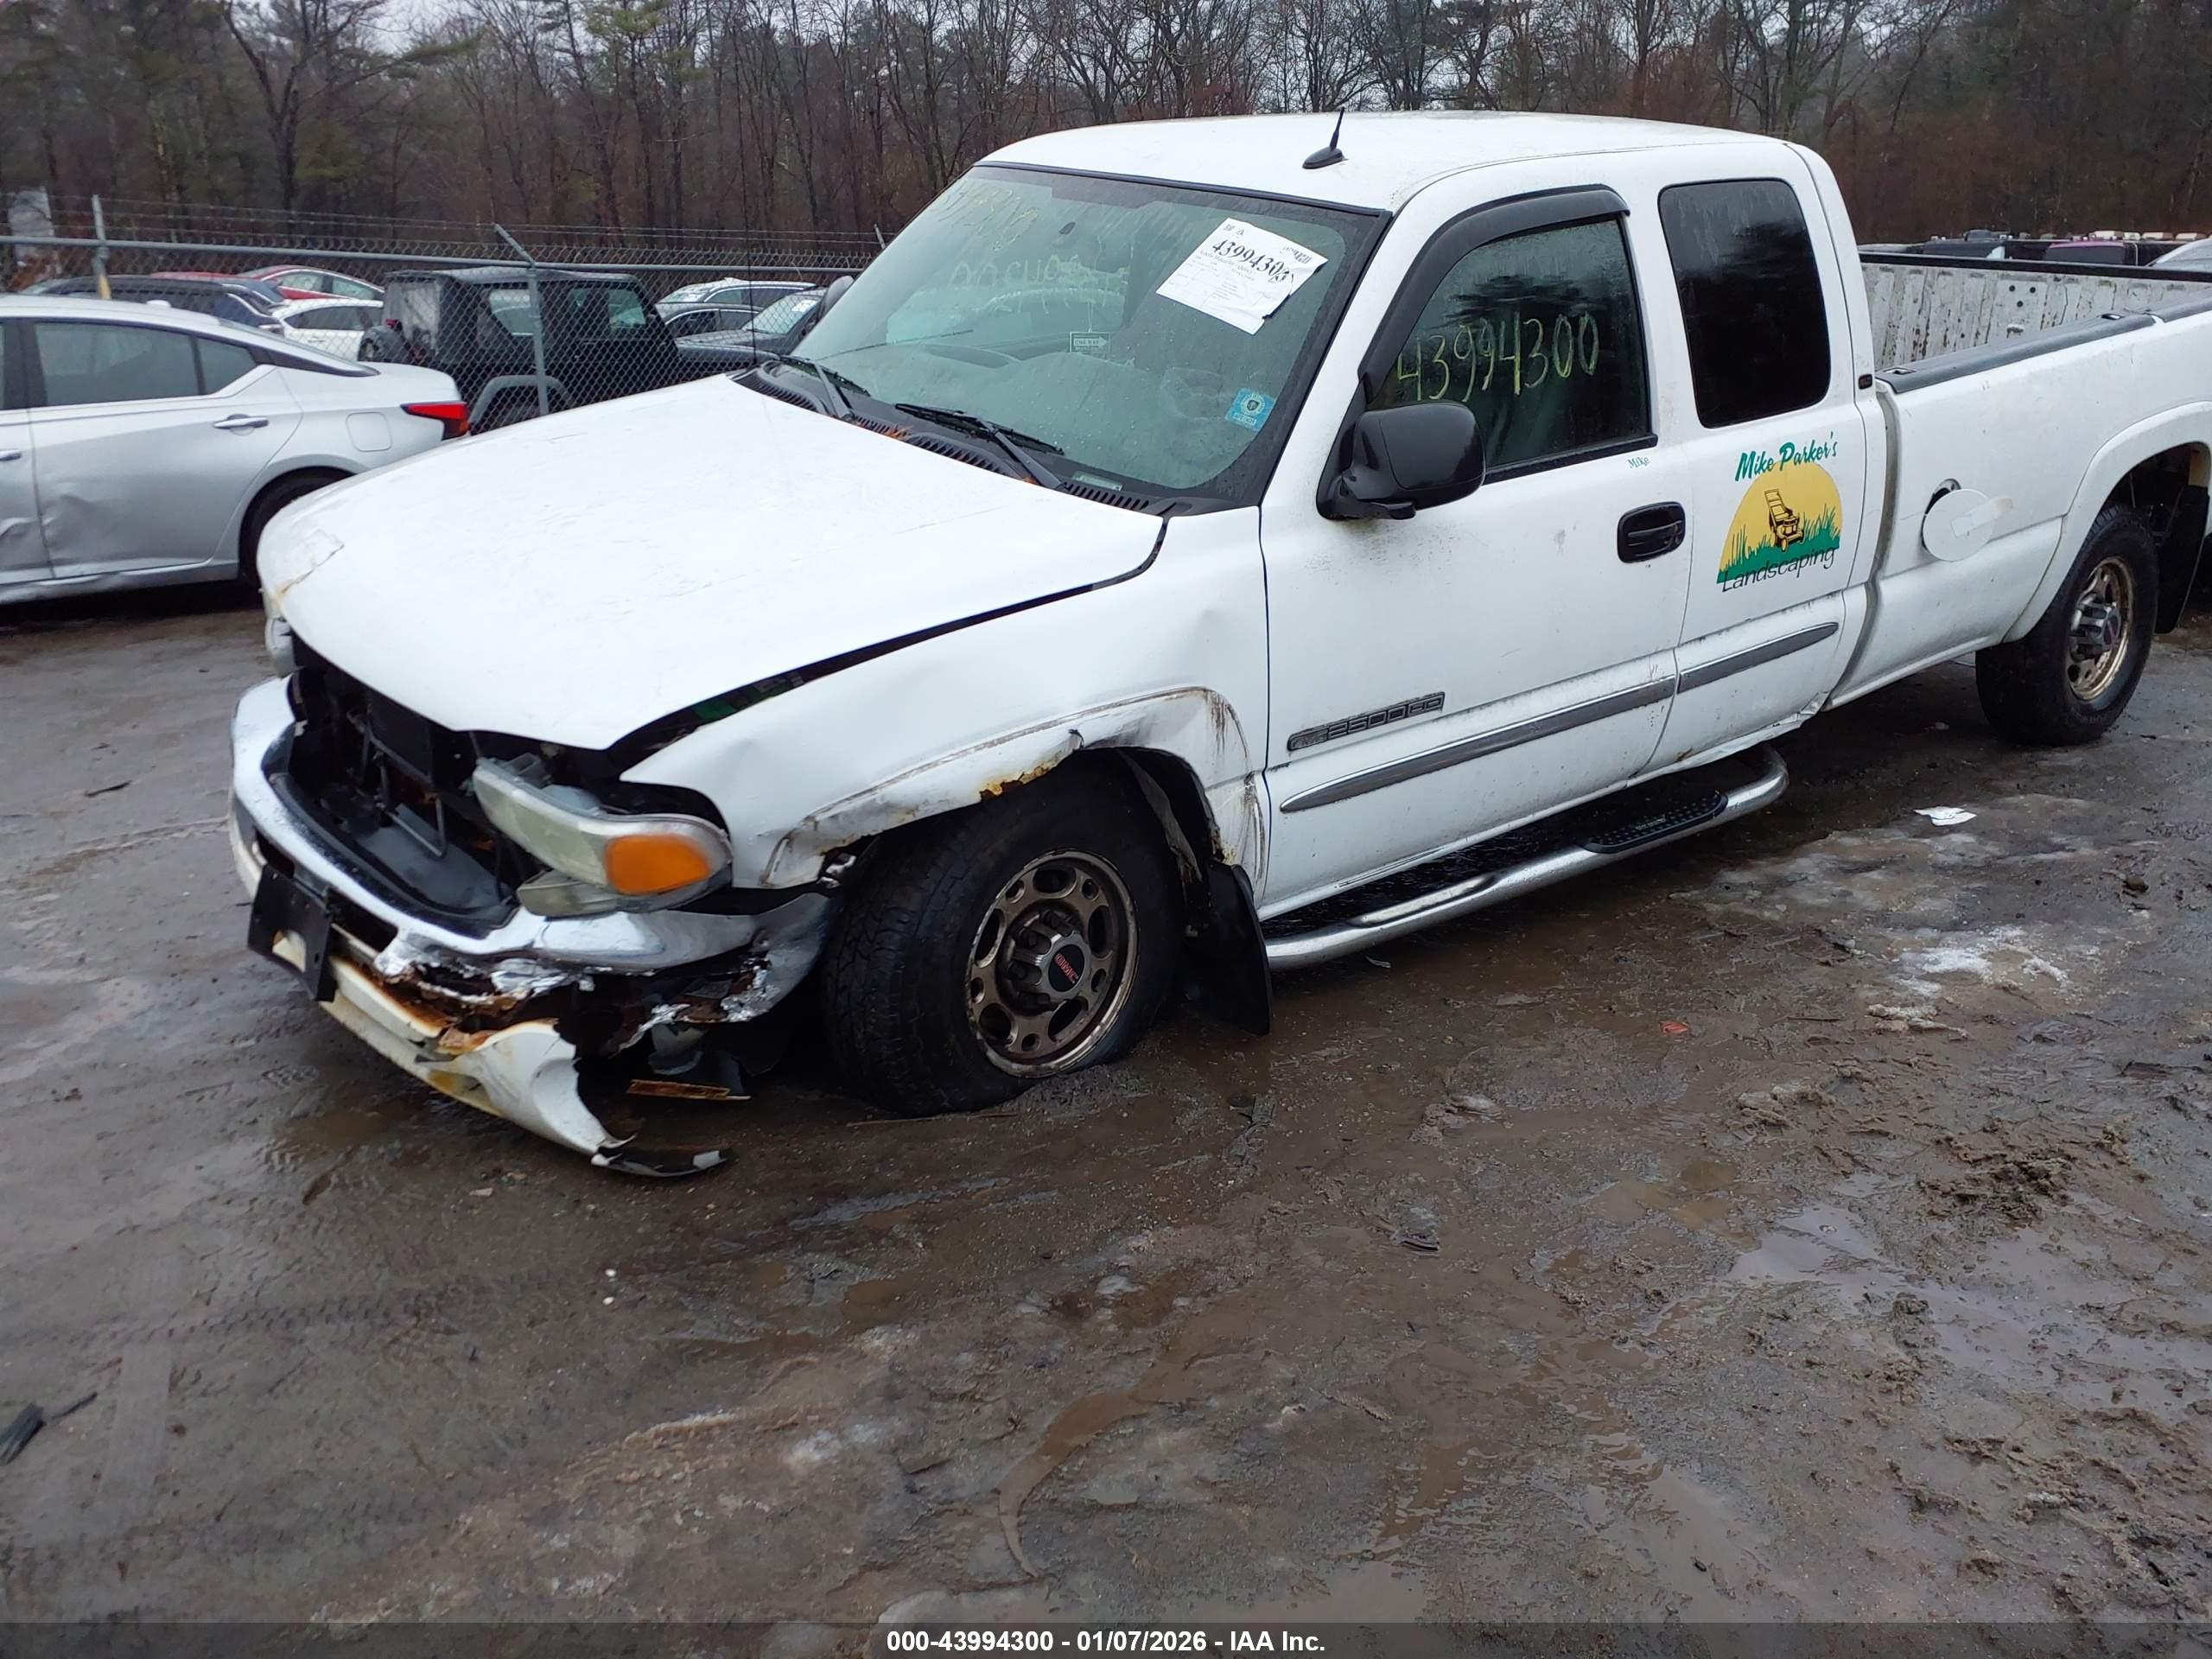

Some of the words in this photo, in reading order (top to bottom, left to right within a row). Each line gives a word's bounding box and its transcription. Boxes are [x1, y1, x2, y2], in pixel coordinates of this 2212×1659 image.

[1396, 311, 1599, 402] 43994300
[1734, 450, 1775, 481] Mike
[1778, 430, 1838, 472] Parker's
[1721, 546, 1836, 592] Landscaping
[1054, 953, 1079, 984] GMC
